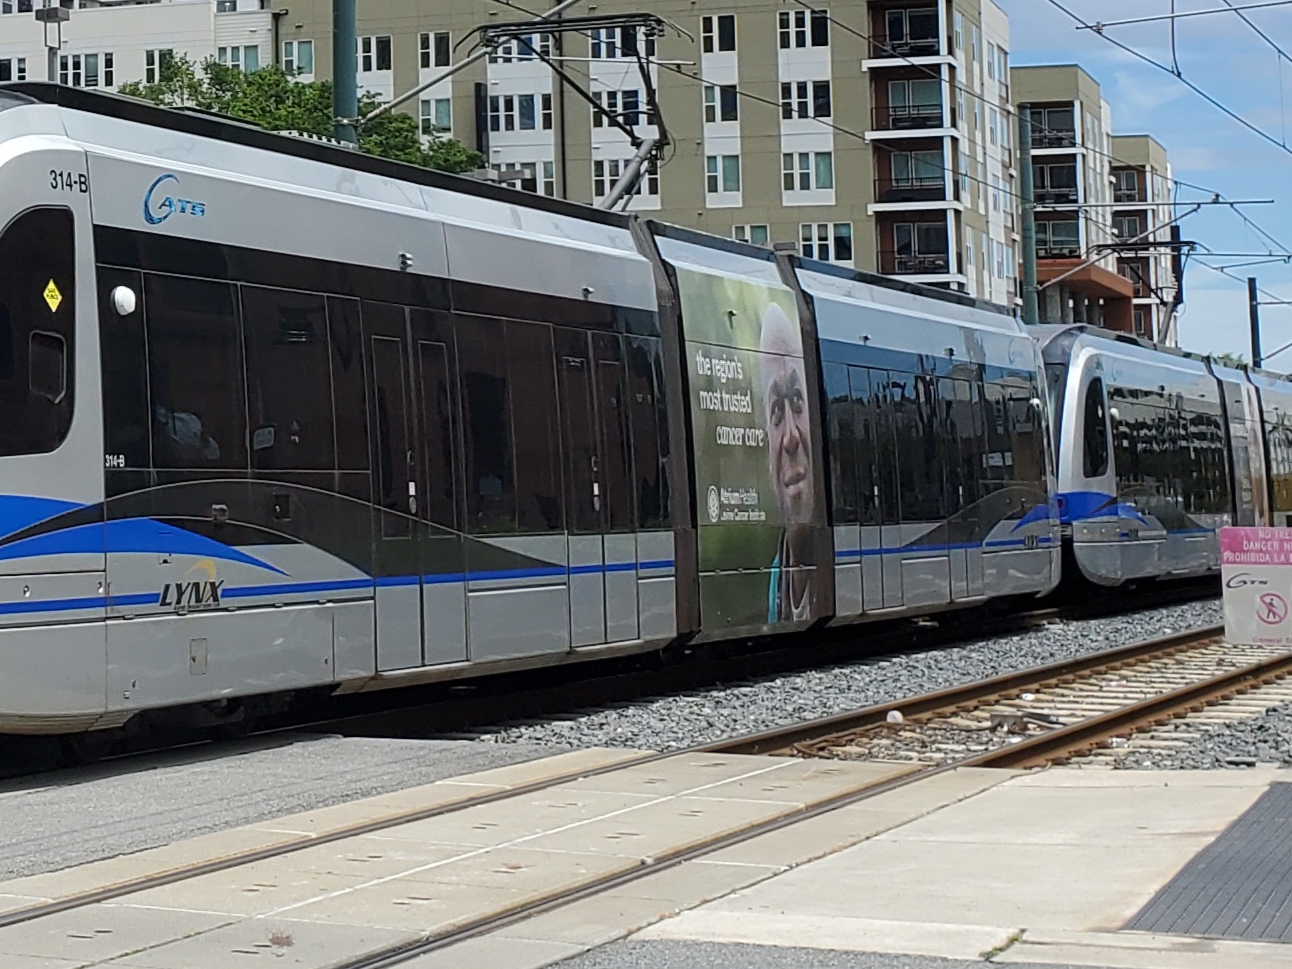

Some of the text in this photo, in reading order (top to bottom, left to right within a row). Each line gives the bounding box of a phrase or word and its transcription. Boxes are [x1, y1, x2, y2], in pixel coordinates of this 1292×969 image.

[49, 169, 89, 194] 314-B
[143, 173, 207, 225] CATS
[696, 350, 743, 383] the region's
[699, 388, 753, 414] most trusted
[716, 425, 764, 447] cancer care
[1243, 540, 1279, 551] DANGER
[1258, 529, 1292, 539] NO TRE
[1223, 552, 1270, 563] PROHIBIDA
[1274, 553, 1287, 563] LA
[159, 579, 225, 607] LYNX
